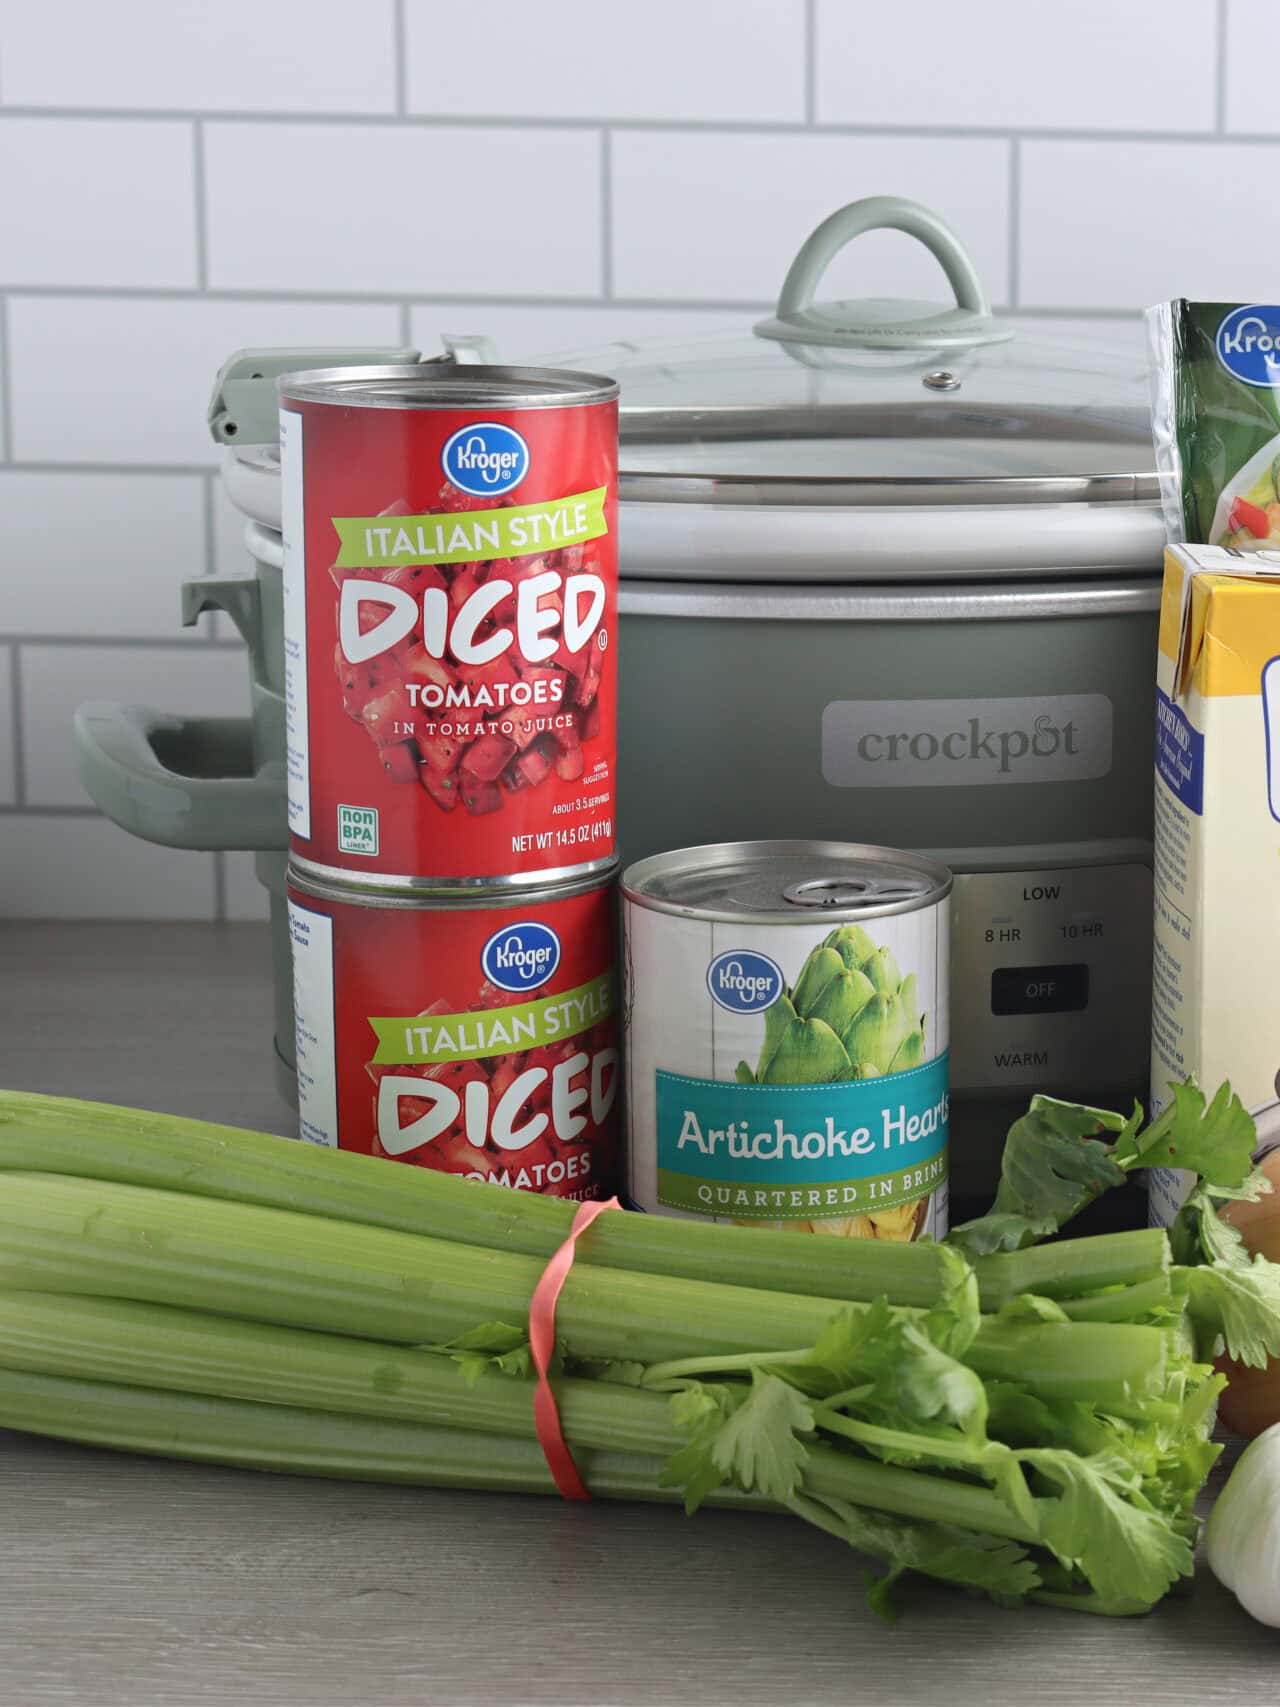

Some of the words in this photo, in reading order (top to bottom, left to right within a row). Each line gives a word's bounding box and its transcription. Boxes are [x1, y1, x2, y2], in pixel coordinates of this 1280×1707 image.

[457, 436, 519, 484] Kroger
[364, 519, 500, 558] ITALIAN
[508, 503, 589, 548] STYLE
[338, 571, 607, 667] DICED
[404, 678, 563, 708] TOMATOES
[393, 721, 415, 735] IN
[427, 720, 514, 737] TOMATO
[523, 715, 574, 733] JUICE
[856, 714, 1080, 774] crockpot
[342, 807, 373, 825] non
[552, 801, 575, 815] ABOUT
[342, 825, 373, 842] BPA
[512, 835, 533, 853] NET
[535, 832, 553, 849] WT
[556, 828, 576, 848] 14.5
[578, 824, 590, 843] OZ
[1023, 886, 1061, 901] LOW
[984, 929, 994, 943] 8
[999, 928, 1021, 942] HR
[1060, 925, 1078, 939] 10
[1082, 924, 1104, 937] HR
[496, 936, 552, 979] Kroger
[719, 961, 773, 1003] Kroger
[1025, 982, 1057, 998] OFF
[404, 1013, 536, 1056] ITALIAN
[543, 983, 609, 1034] STYLE
[994, 1051, 1048, 1068] WARM
[377, 1049, 617, 1156] DICED
[676, 1110, 876, 1160] Artichoke
[698, 1185, 857, 1207] QUARTERED
[869, 1179, 894, 1199] IN
[902, 1157, 945, 1190] BRINE
